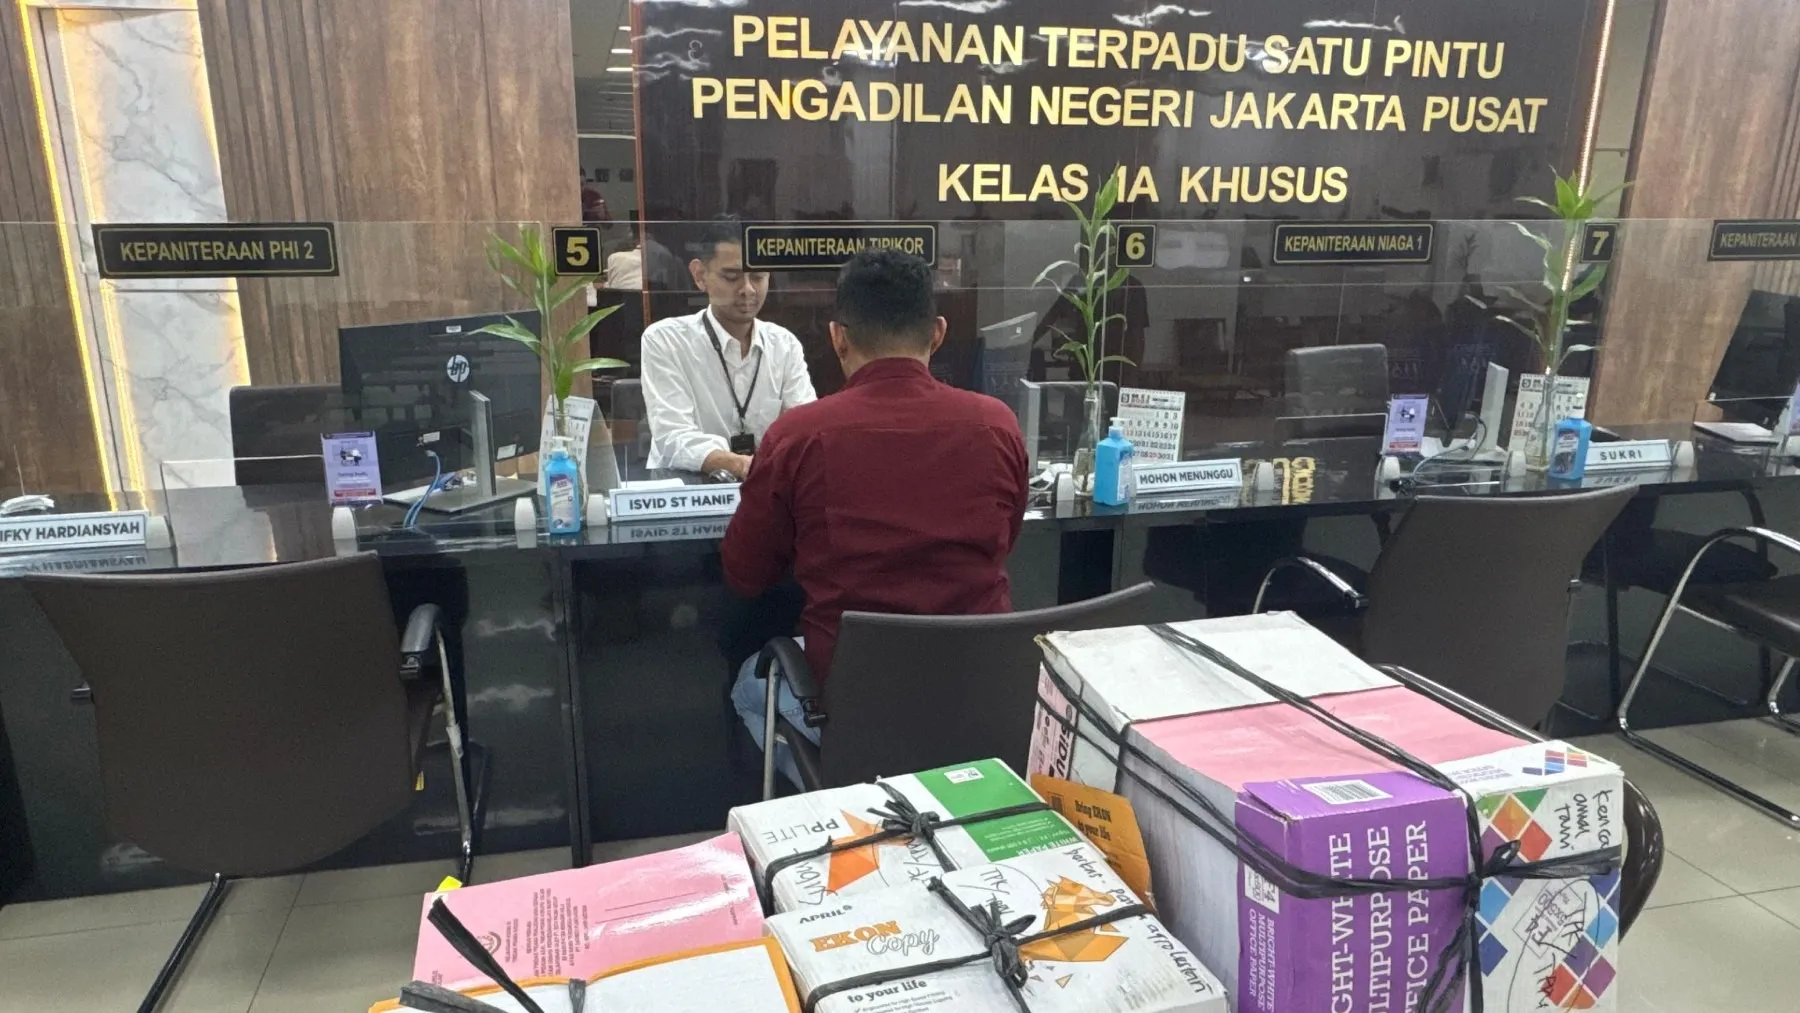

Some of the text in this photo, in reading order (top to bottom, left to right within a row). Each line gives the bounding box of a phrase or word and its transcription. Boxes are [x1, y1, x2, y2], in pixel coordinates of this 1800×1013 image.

[732, 15, 1505, 79] PELAYANAN TERPADU SATU PINTU
[692, 78, 1548, 133] PENGADILAN NEGERI JAKARTA PUSAT
[938, 163, 1089, 202] KELAS
[1180, 166, 1348, 203] KHUSUS
[120, 240, 315, 262] KEPANITERAAN PHI 2
[566, 236, 590, 266] 5
[757, 238, 865, 256] KEPANITERAAN
[1126, 233, 1145, 260] 6
[1285, 235, 1423, 253] KEPANITERAAN NIAGA 1
[1591, 232, 1609, 256] 7
[1720, 231, 1798, 248] KEPANITERAAN
[1600, 449, 1642, 461] SUKRI
[1139, 468, 1234, 485] MOHON MENUNGGU
[629, 494, 735, 510] ISVID ST HANIF
[36, 521, 139, 539] HARDIANSYAH
[763, 818, 839, 845] PPLITE
[1047, 837, 1078, 850] WHITE
[1405, 821, 1429, 927] PAPER
[810, 920, 902, 952] EKON
[867, 929, 940, 956] Copy
[1249, 908, 1257, 997] OFFICE PAPER
[1257, 912, 1267, 1012] MULTIPURPOSE
[1267, 918, 1276, 1013] BRIGHT-WHITE
[847, 979, 927, 1003] to your life
